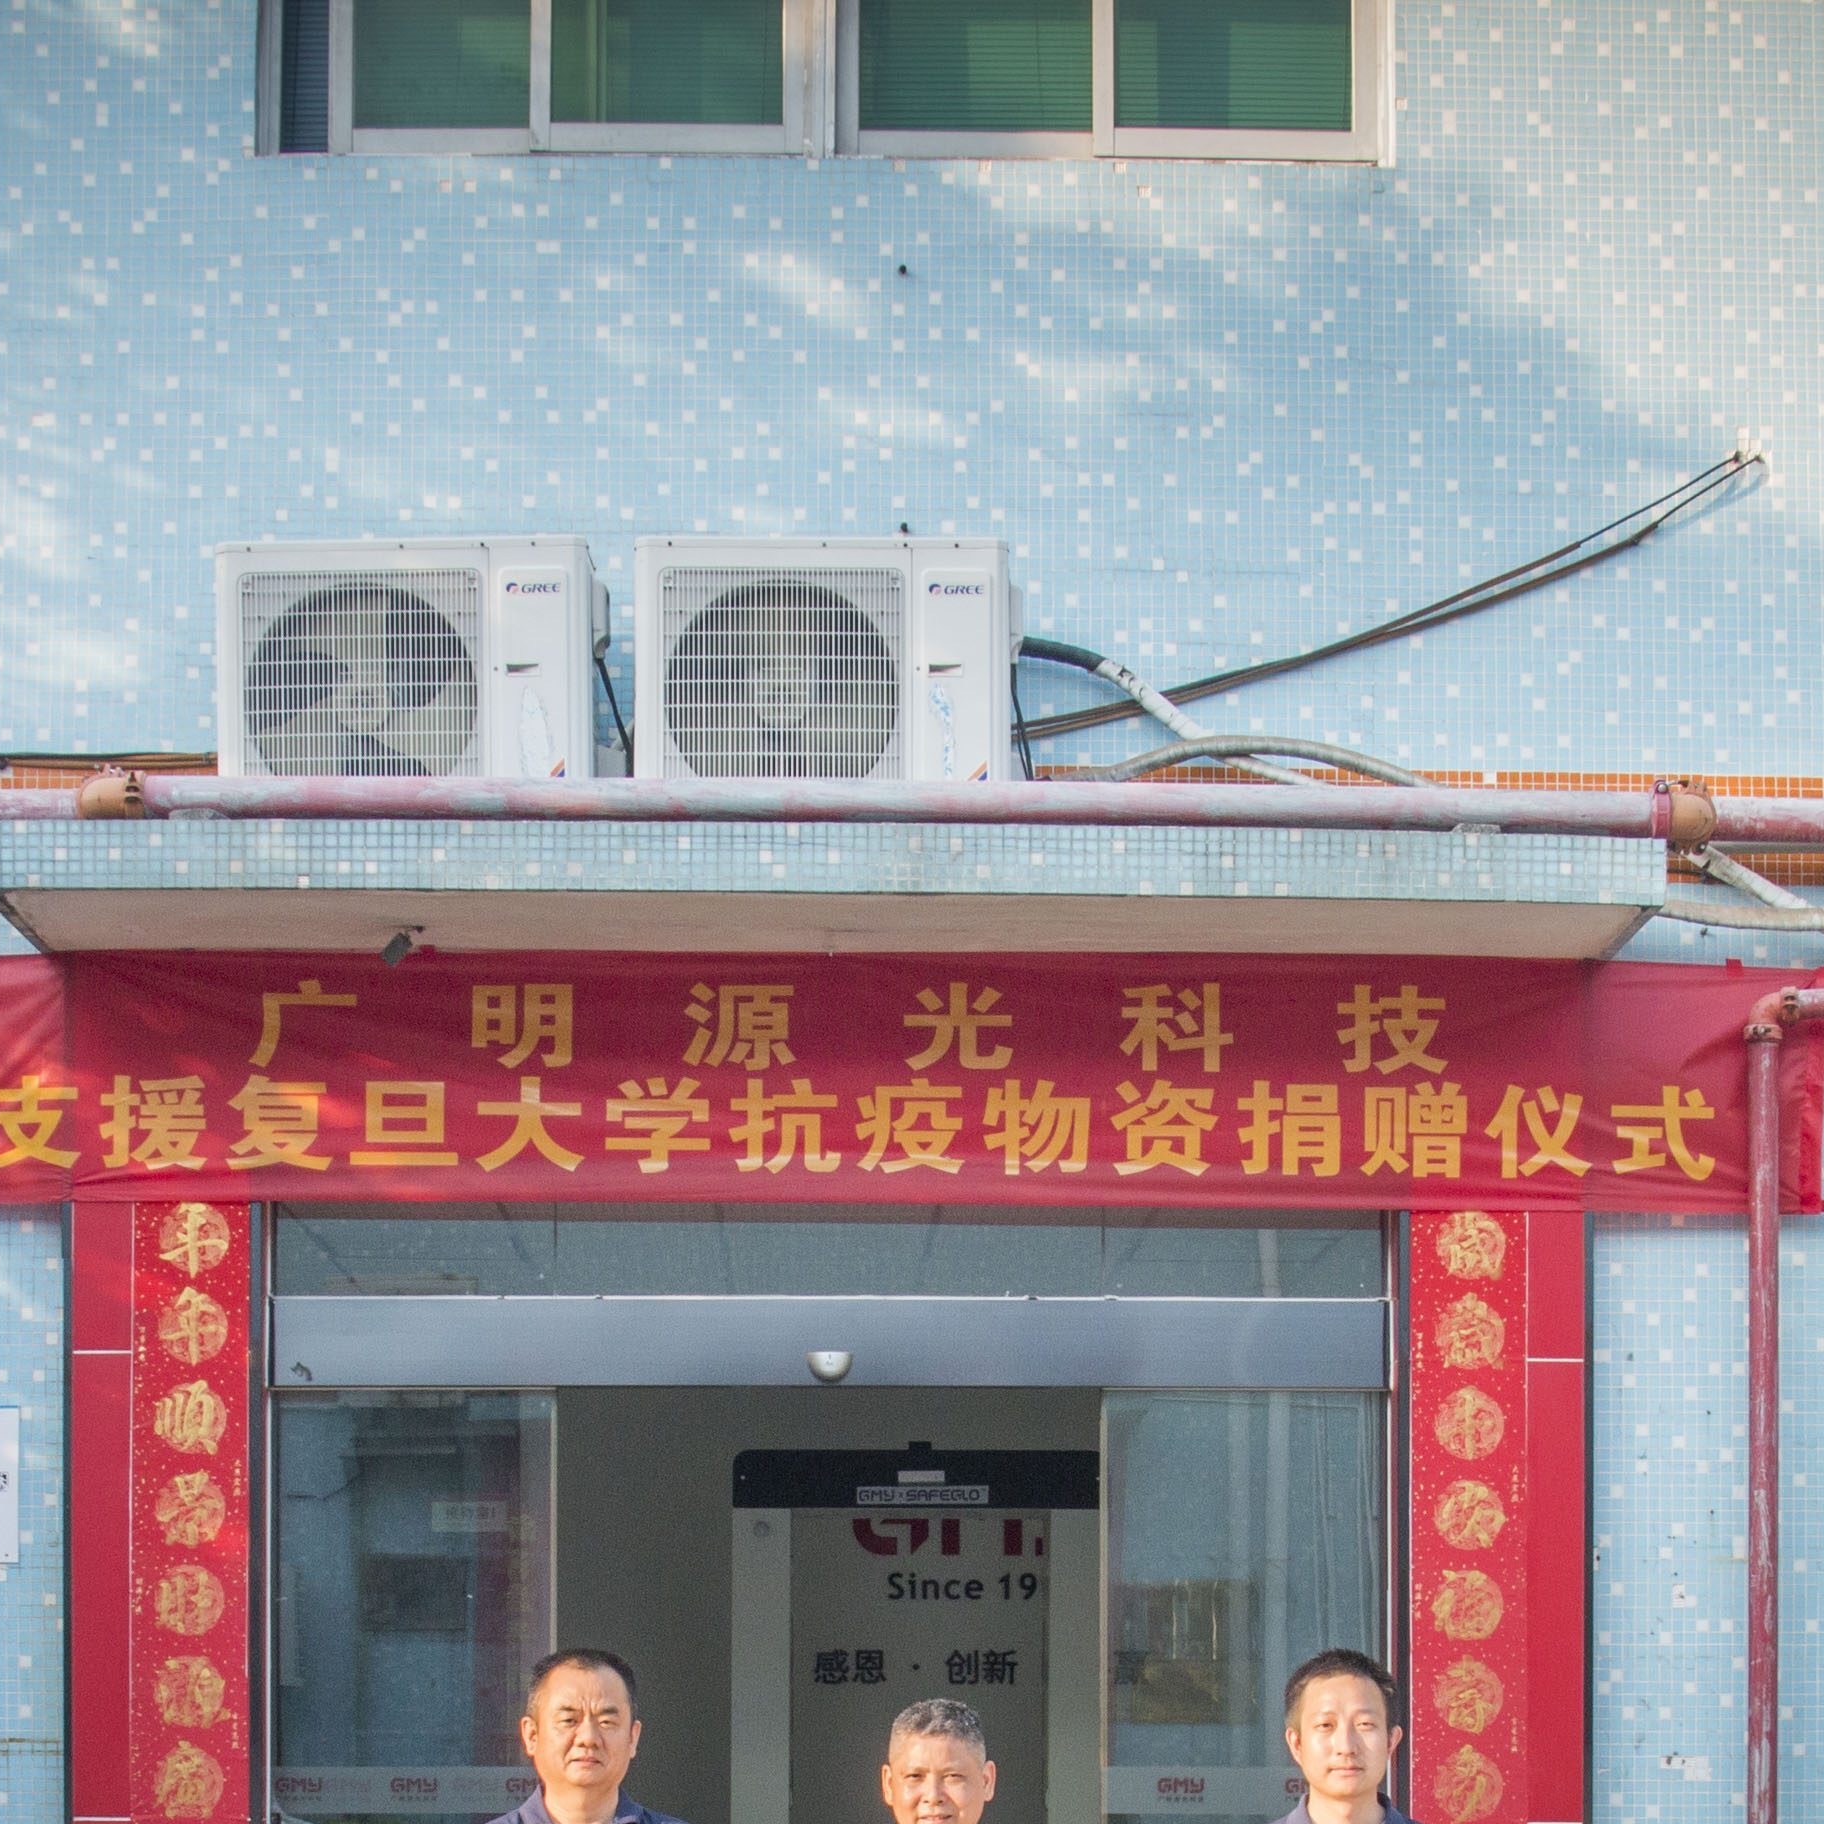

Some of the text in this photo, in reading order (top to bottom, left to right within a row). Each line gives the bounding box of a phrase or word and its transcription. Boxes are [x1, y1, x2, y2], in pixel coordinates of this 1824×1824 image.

[521, 583, 561, 593] GREE
[944, 585, 984, 595] GREE
[249, 980, 1448, 1074] 广明源光科技
[887, 1572, 984, 1600] Since
[814, 1648, 887, 1684] 感恩
[945, 1649, 1019, 1685] 创新
[390, 1777, 437, 1793] GMY
[505, 1777, 539, 1793] GM
[1157, 1777, 1205, 1794] GMY
